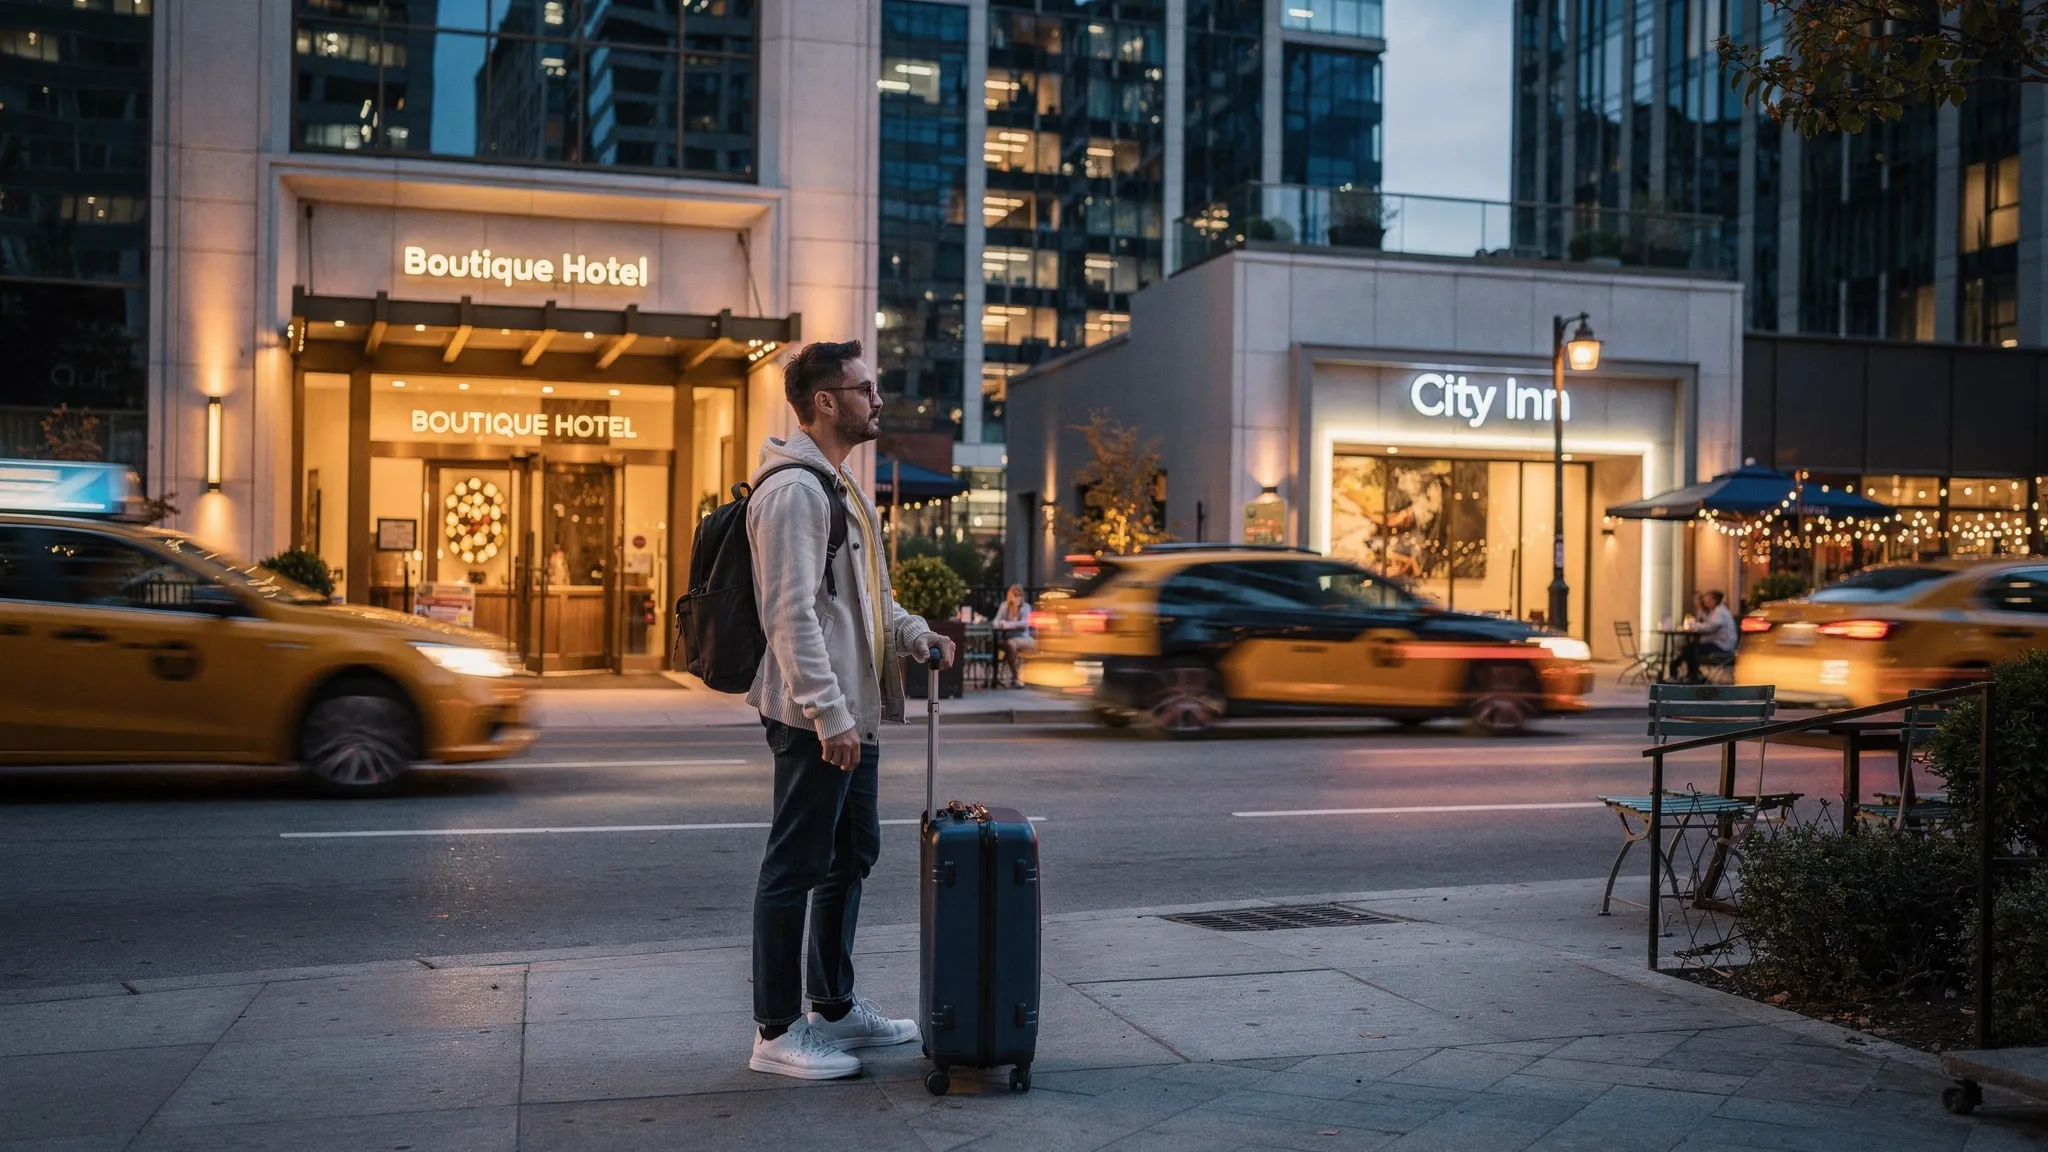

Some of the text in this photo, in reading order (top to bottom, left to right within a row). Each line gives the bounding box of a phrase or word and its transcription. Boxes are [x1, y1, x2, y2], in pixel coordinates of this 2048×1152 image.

[404, 246, 648, 287] Boutique Hotel
[1411, 373, 1570, 428] City Inn
[411, 410, 637, 438] BOUTIQUE HOTEL
